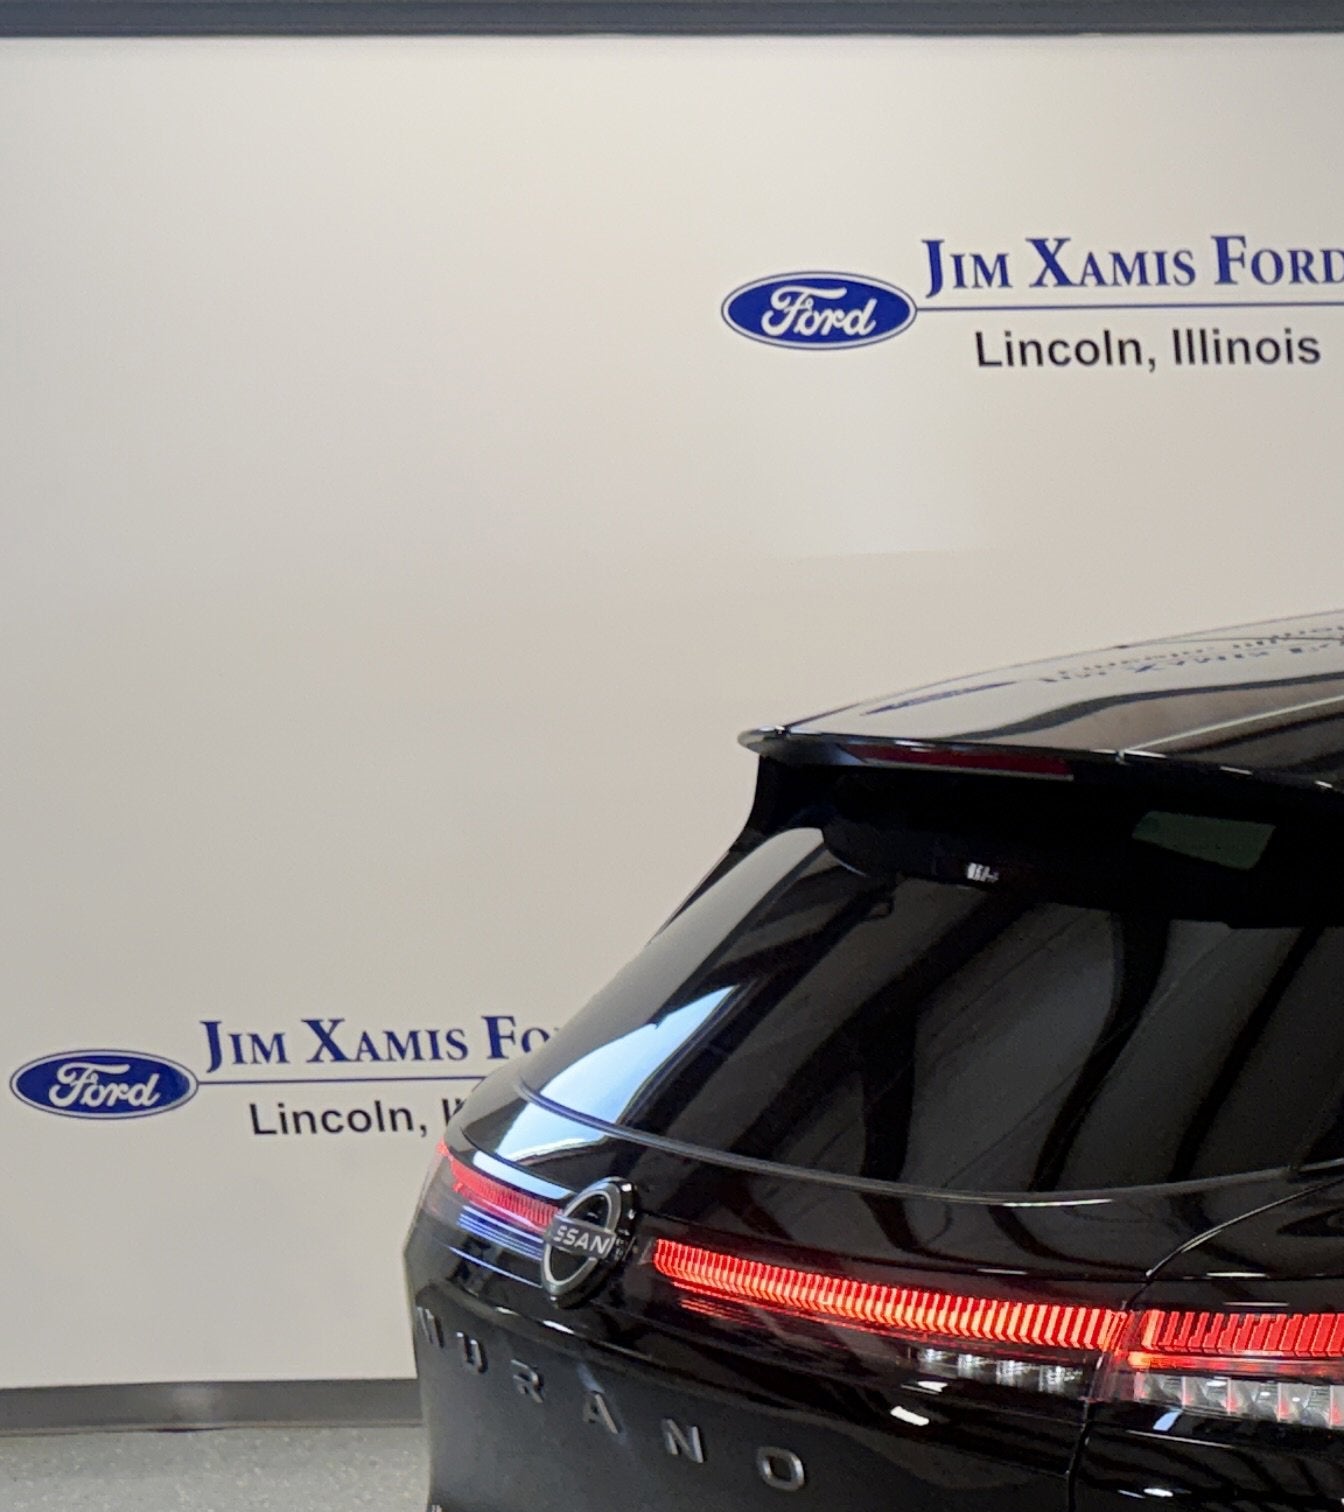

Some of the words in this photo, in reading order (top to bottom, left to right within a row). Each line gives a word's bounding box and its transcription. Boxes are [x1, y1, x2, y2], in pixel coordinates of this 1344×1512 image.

[921, 239, 1012, 299] JIM
[1026, 238, 1196, 288] XAMIS
[760, 284, 878, 338] Ford
[975, 329, 1156, 373] Lincoln,
[1172, 328, 1321, 366] Illinois
[200, 1020, 289, 1074] JIM
[301, 1018, 468, 1063] XAMIS
[481, 1015, 560, 1061] FO
[47, 1061, 164, 1109] Ford
[249, 1102, 428, 1138] Lincoln,
[552, 1223, 612, 1255] SSAN
